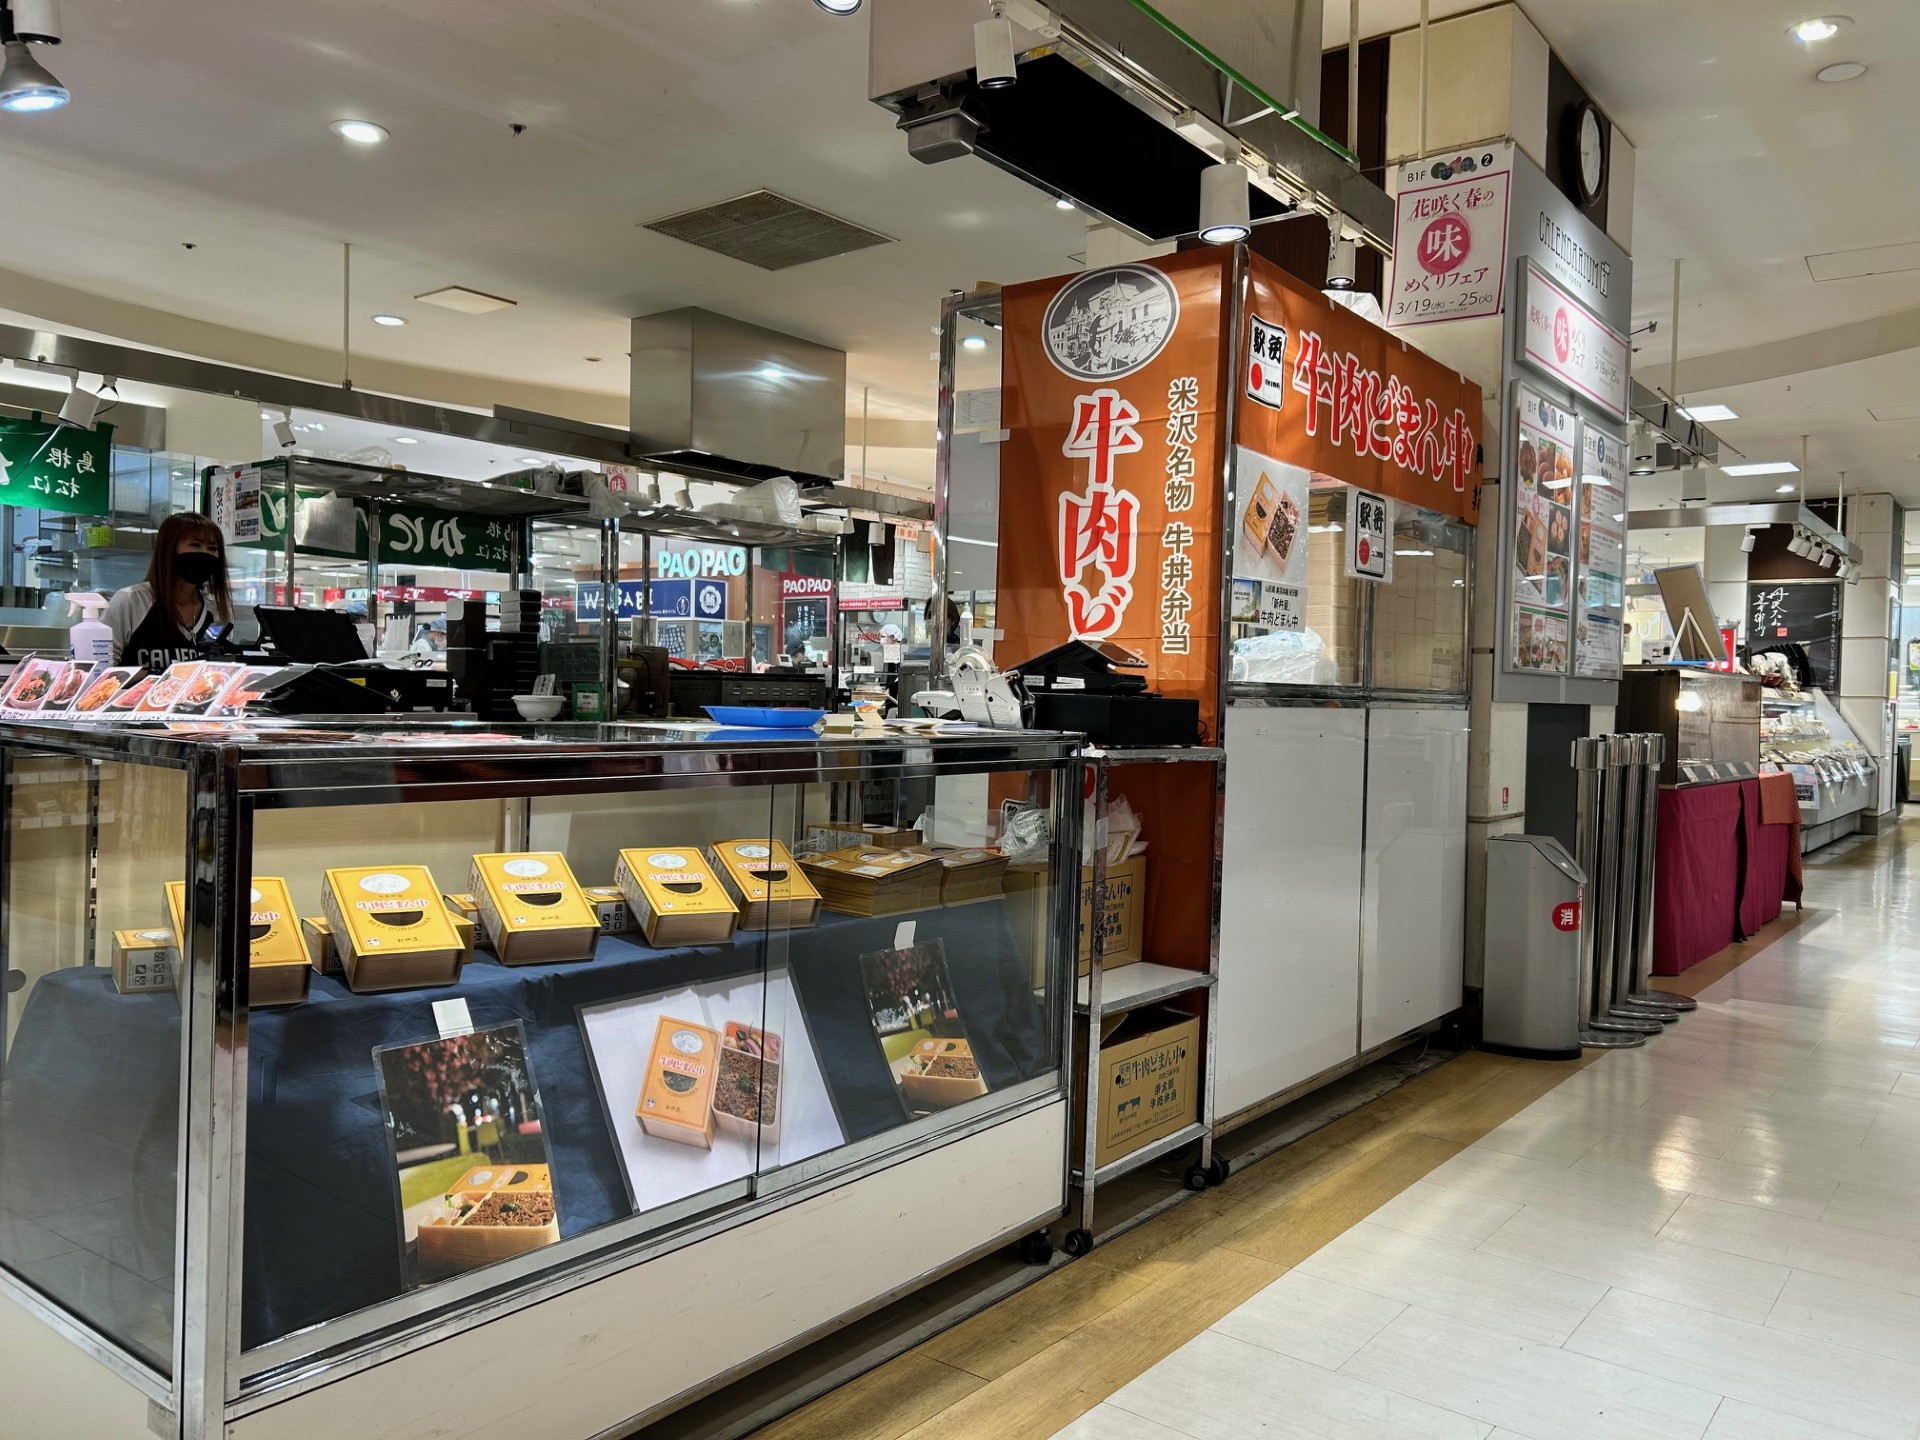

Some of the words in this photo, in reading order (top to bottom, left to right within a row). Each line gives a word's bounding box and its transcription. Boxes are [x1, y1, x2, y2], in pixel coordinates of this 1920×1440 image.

[1407, 170, 1426, 183] B1F
[1413, 187, 1495, 218] 花咲く春の
[1426, 224, 1463, 263] 味
[1540, 211, 1599, 289] CALENDARIUM
[1404, 267, 1489, 293] めぐりフェア
[1292, 330, 1473, 492] 牛肉どまん中
[1167, 377, 1198, 513] 米沢名物
[658, 547, 746, 578] PAOPAO
[584, 586, 654, 614] WSABI
[783, 578, 832, 594] PAOPAO
[1161, 521, 1193, 656] 牛丼弁当
[1261, 610, 1299, 629] 牛肉どまん中
[137, 648, 203, 668] CALIFO
[1132, 1045, 1182, 1080] 牛肉どまん中
